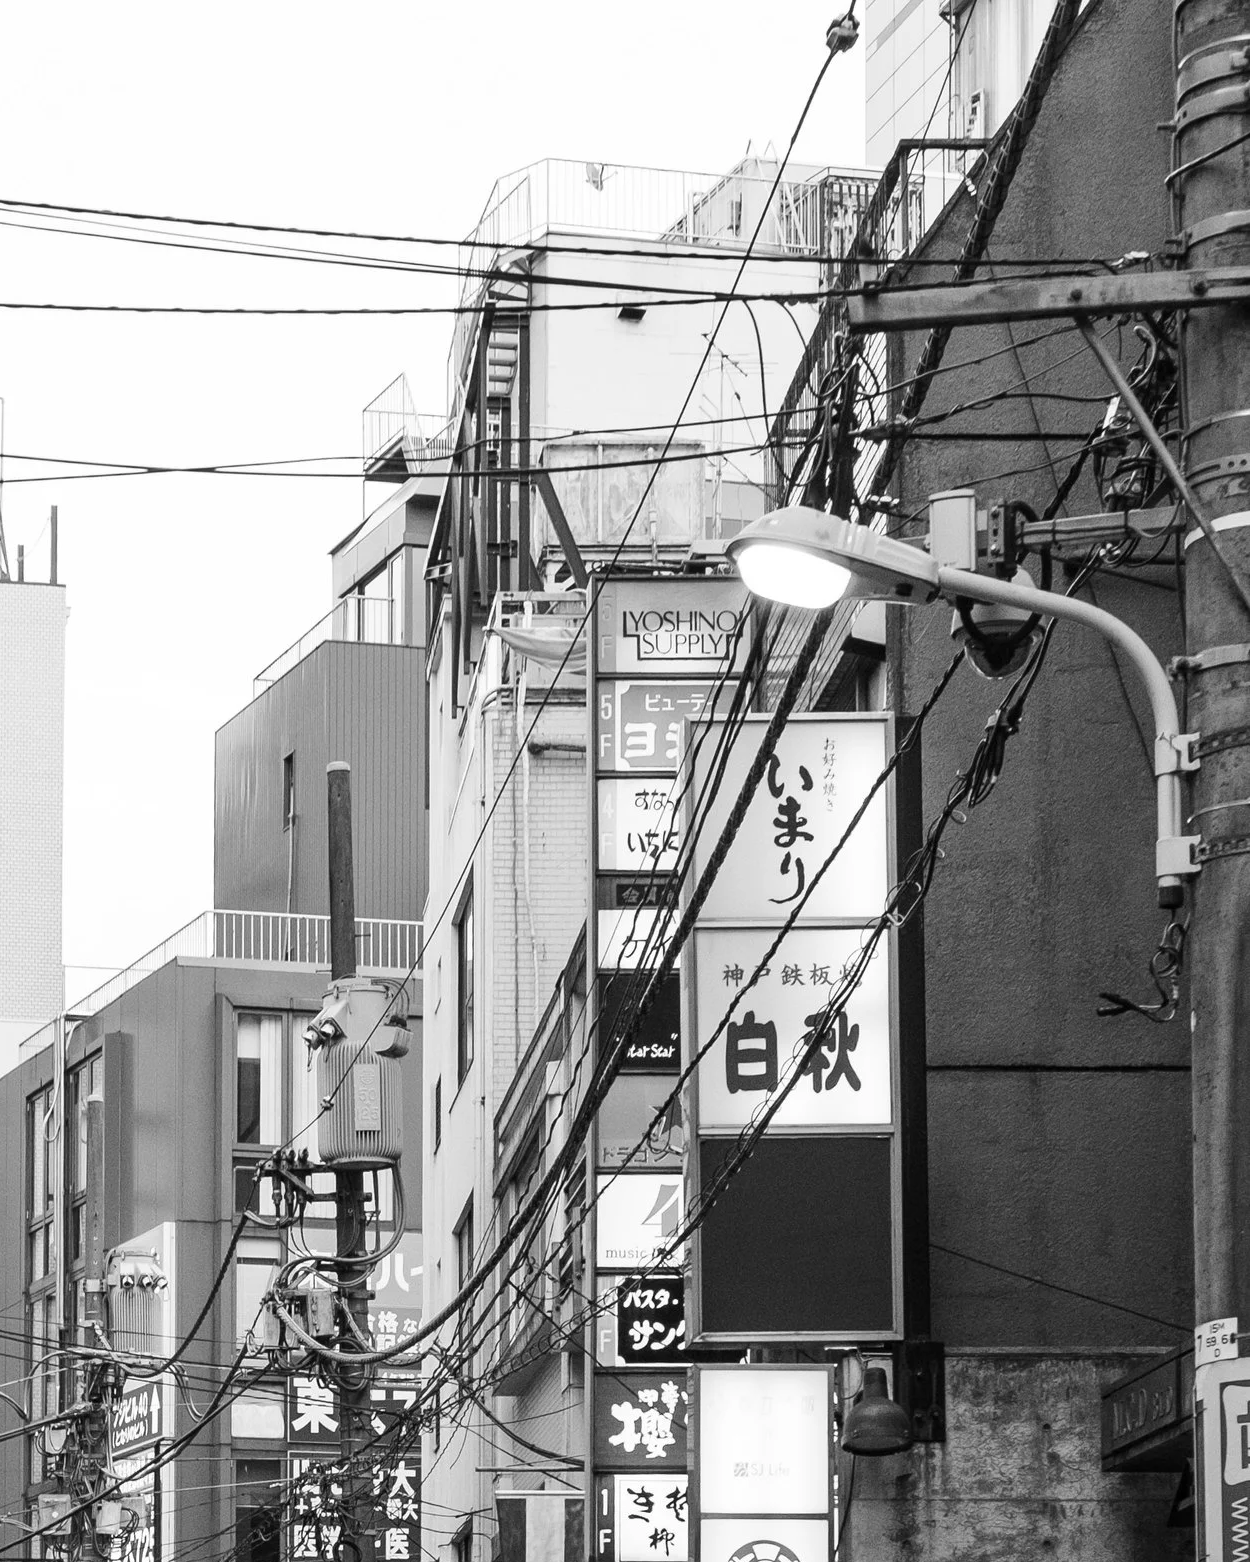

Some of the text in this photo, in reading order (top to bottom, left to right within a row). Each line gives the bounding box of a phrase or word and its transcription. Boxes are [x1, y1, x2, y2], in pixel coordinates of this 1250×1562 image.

[629, 611, 738, 633] YOSHINO
[643, 633, 723, 655] SUPPLY
[823, 737, 838, 812] お好み焼き
[767, 753, 814, 904] いまり
[726, 1011, 862, 1094] 白秋
[605, 1247, 646, 1260] music
